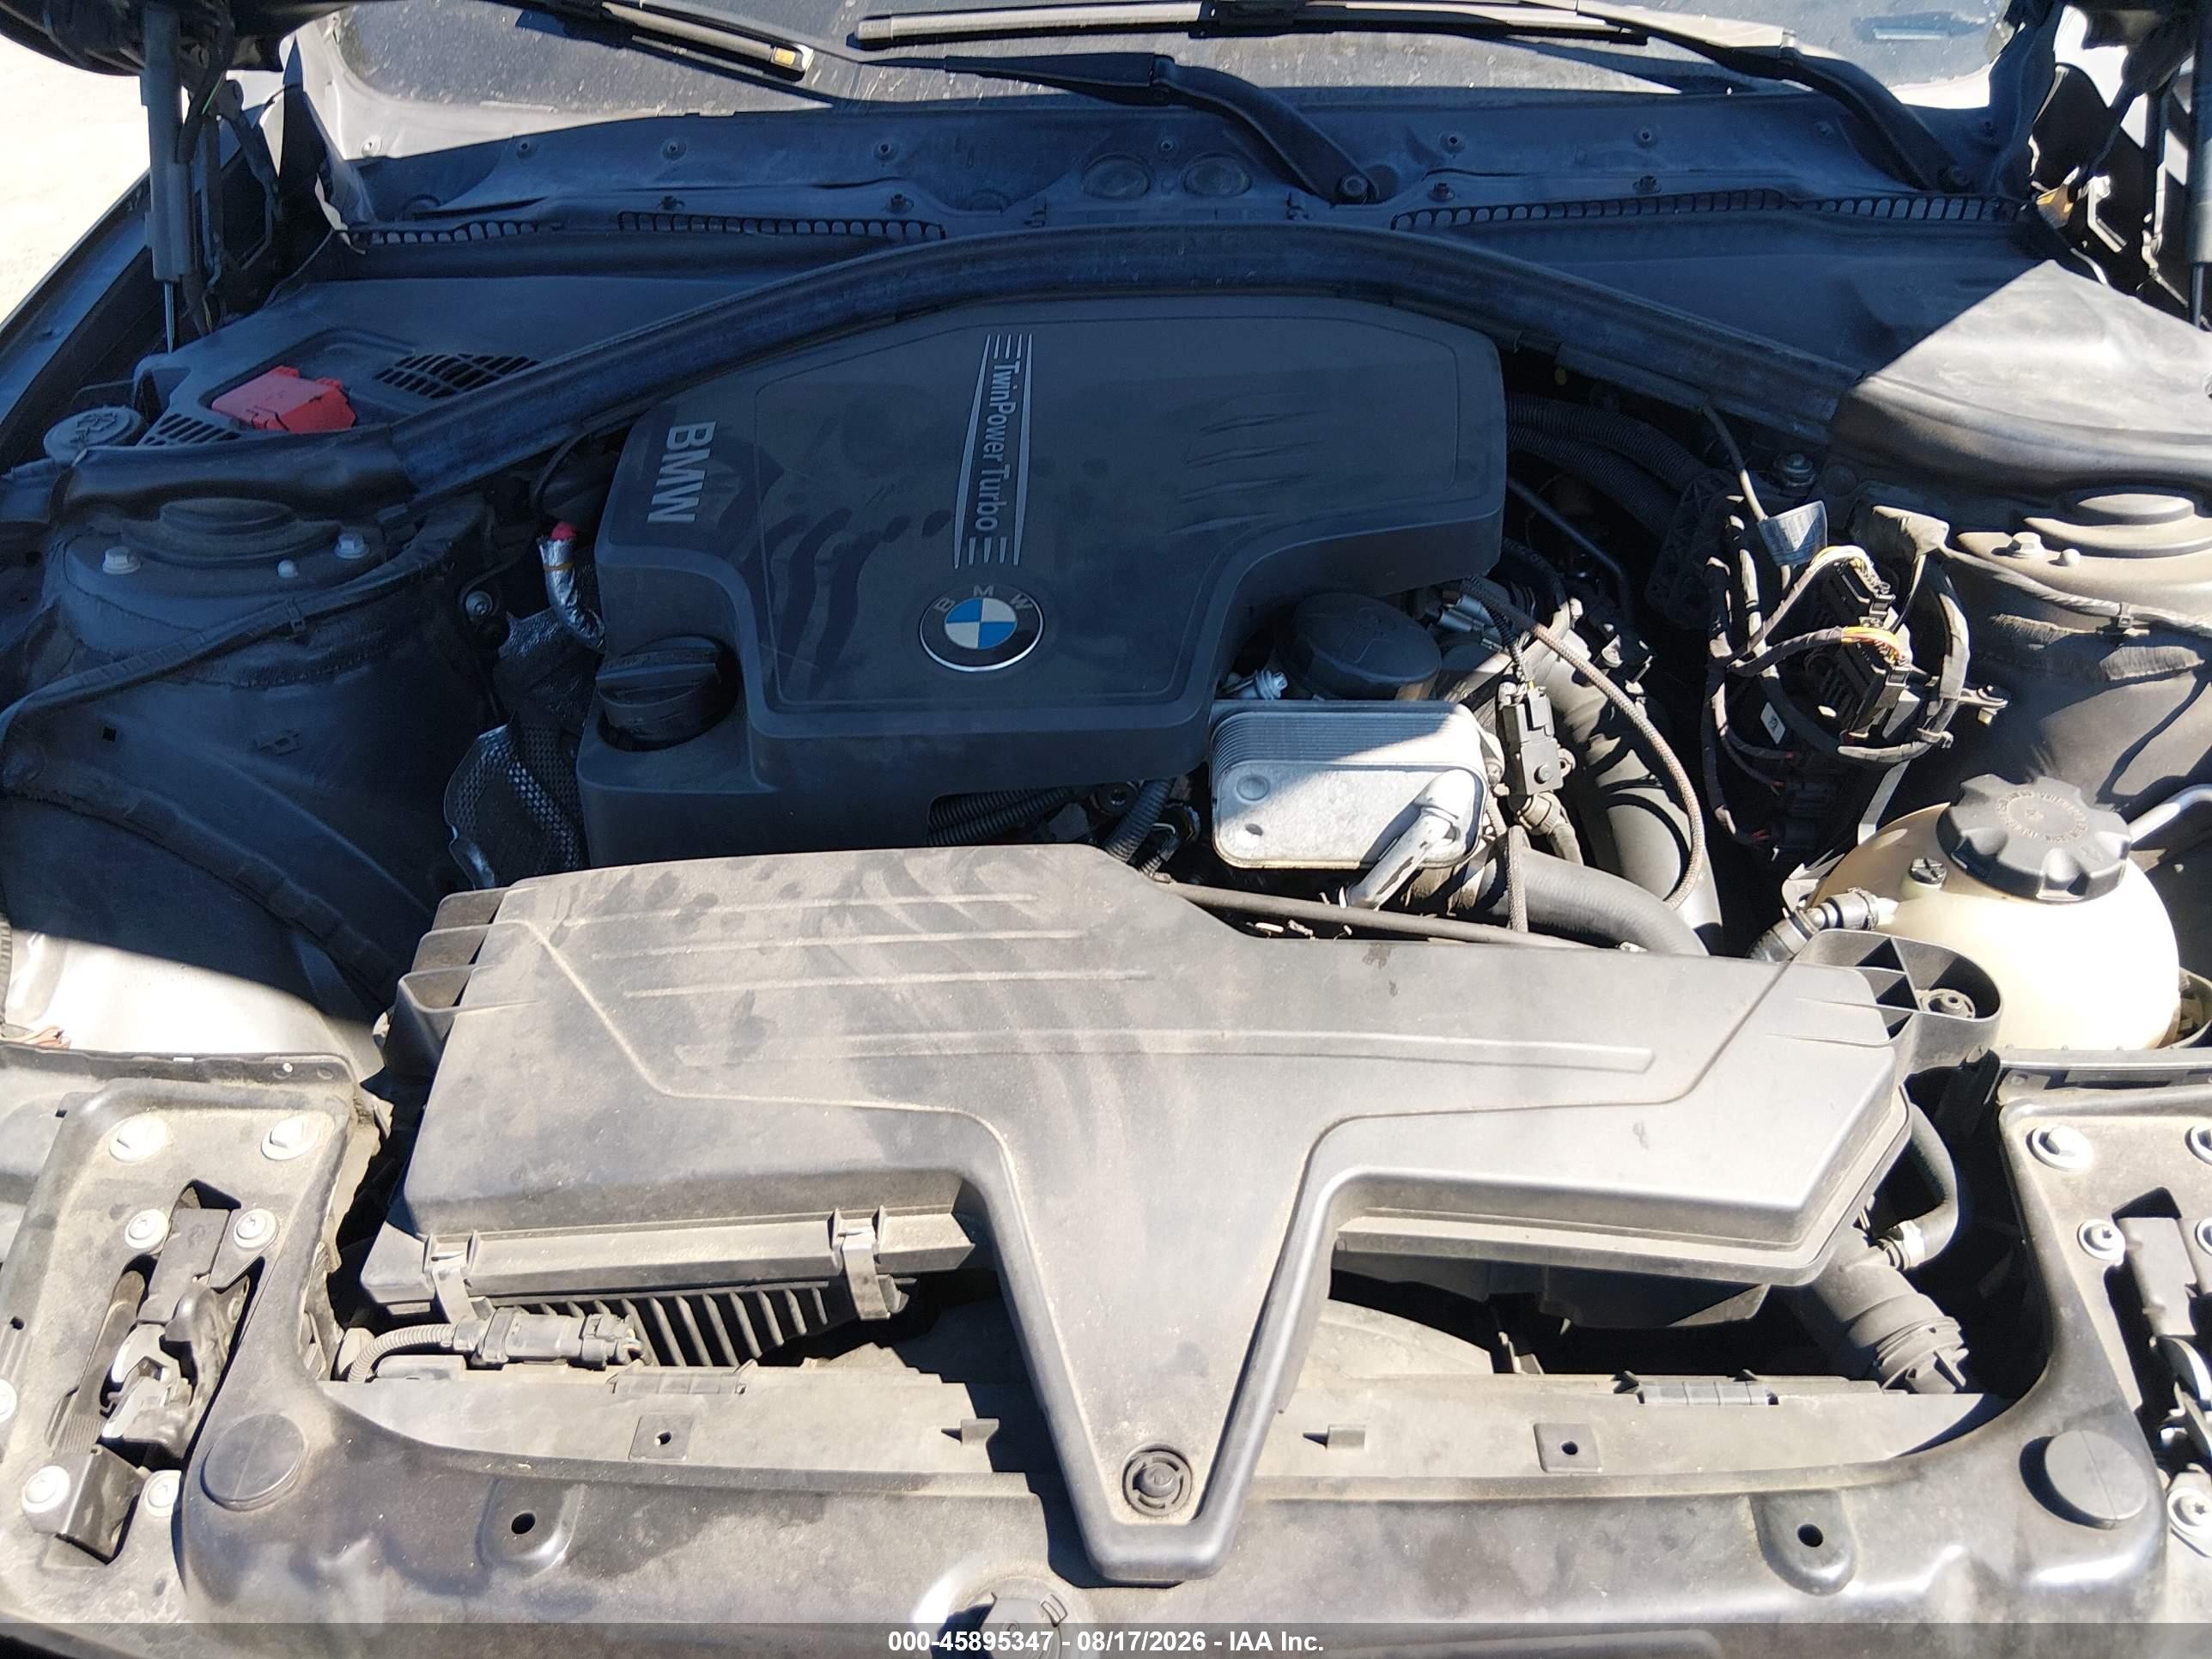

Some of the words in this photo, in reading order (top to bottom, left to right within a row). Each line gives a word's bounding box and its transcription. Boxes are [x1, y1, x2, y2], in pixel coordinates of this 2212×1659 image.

[982, 359, 1021, 463] TwinPower
[647, 421, 716, 523] BMW
[975, 464, 1011, 532] Turbo
